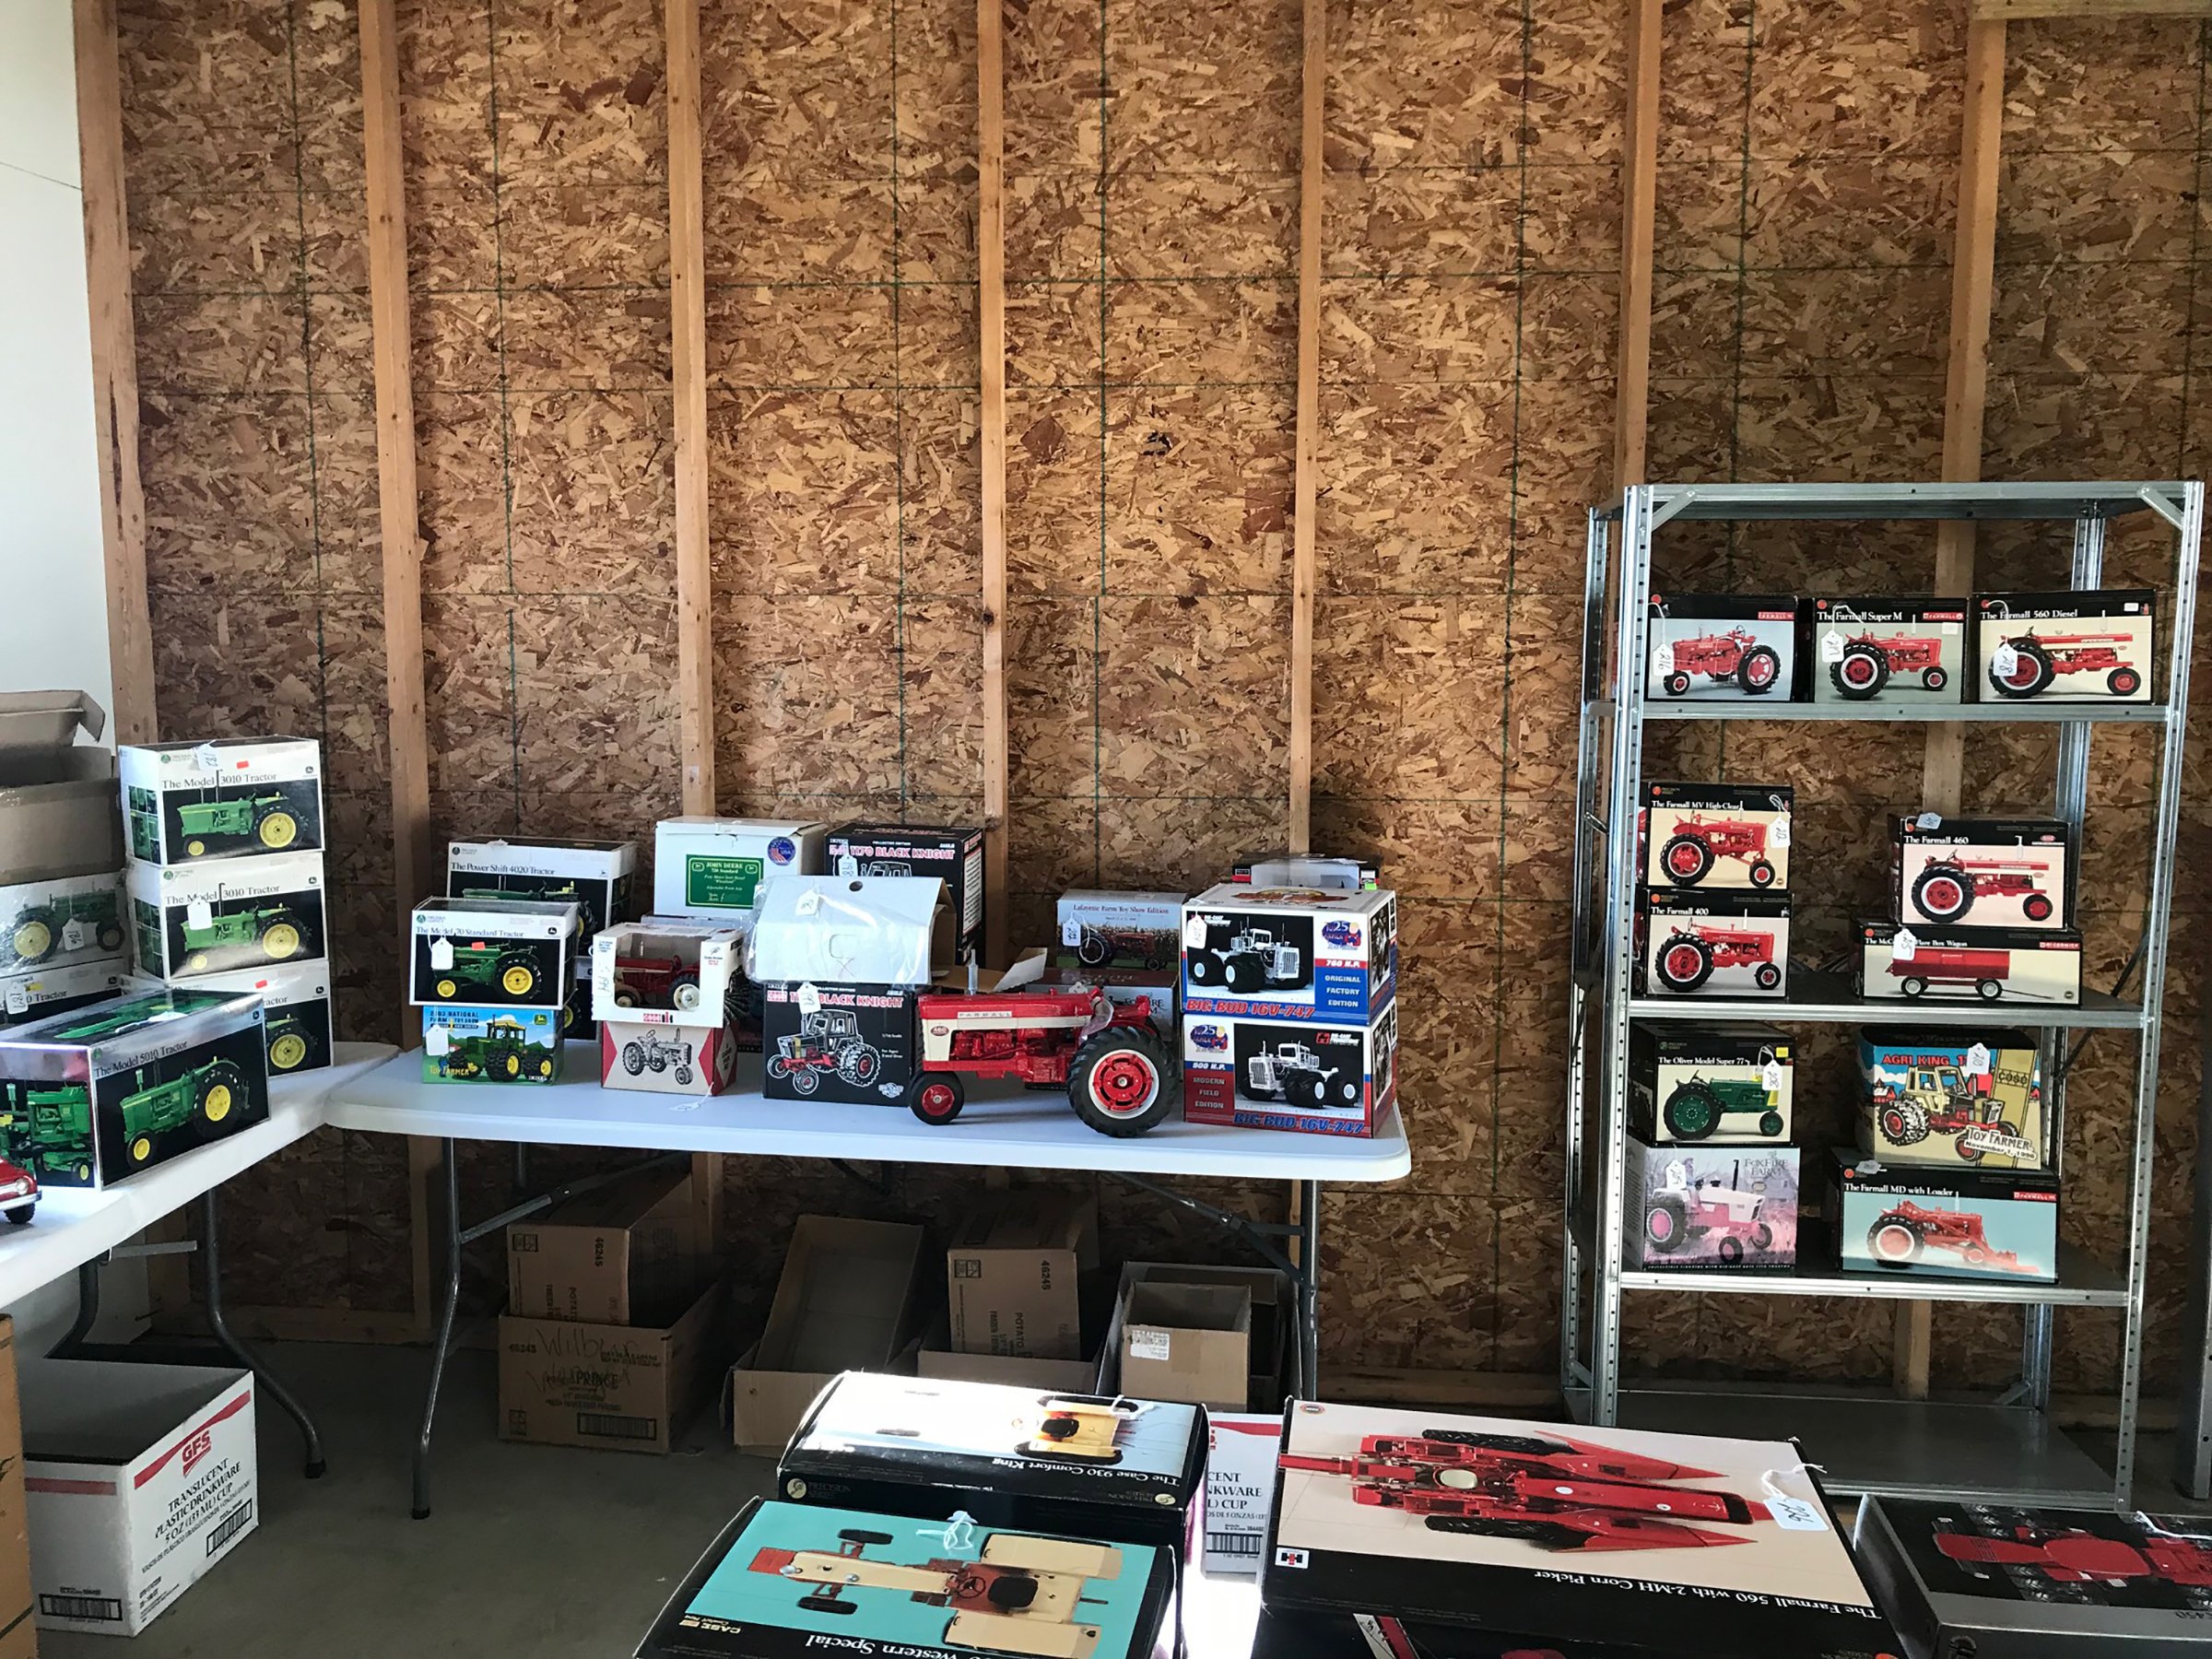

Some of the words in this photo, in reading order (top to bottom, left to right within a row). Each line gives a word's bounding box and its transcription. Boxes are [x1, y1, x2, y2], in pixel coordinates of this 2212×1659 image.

[1818, 612, 1833, 620] The
[1836, 612, 1867, 620] Farmall
[1868, 612, 1892, 622] Super
[1893, 612, 1902, 620] M
[1981, 611, 1996, 619] The
[2000, 610, 2030, 619] Farmall
[2033, 610, 2050, 618] 560
[2052, 609, 2077, 618] Diesel
[1659, 651, 1671, 669] 216
[2000, 655, 2015, 673] 218
[163, 779, 182, 790] The
[183, 776, 215, 788] Model
[221, 775, 242, 785] 3010
[244, 773, 277, 783] Tractor
[1706, 802, 1741, 810] High-Clear
[876, 846, 911, 858] BLACK
[912, 848, 955, 860] KNIGHT
[451, 863, 466, 871] The
[467, 864, 489, 872] Power
[490, 865, 508, 873] Shift
[509, 865, 529, 874] 4020
[530, 866, 556, 876] Tractor
[166, 896, 184, 905] The
[223, 888, 245, 899] 3010
[248, 886, 280, 896] Tractor
[1147, 906, 1170, 914] Edition
[465, 928, 498, 936] Standard
[500, 929, 525, 937] Tractor
[1324, 975, 1360, 983] ORIGINAL
[36, 991, 67, 1002] Tractor
[1326, 987, 1360, 995] FACTORY
[265, 996, 288, 1006] ractor
[819, 992, 856, 1006] BLACK
[857, 994, 904, 1007] KNIGHT
[1328, 999, 1359, 1008] EDITION
[1186, 998, 1212, 1012] BIG
[1215, 1001, 1248, 1015] BUD
[1250, 1003, 1316, 1019] 16V-747
[95, 1066, 112, 1077] The
[112, 1055, 140, 1071] Model
[140, 1049, 160, 1064] 5010
[162, 1041, 189, 1057] Tractor
[1673, 1056, 1693, 1065] Oliver
[1716, 1057, 1735, 1066] Super
[1882, 1054, 1912, 1065] AGRI
[1917, 1055, 1950, 1065] KING
[1194, 1077, 1225, 1086] MODERN
[1199, 1089, 1219, 1098] FIELD
[1194, 1100, 1224, 1109] EDITION
[1233, 1112, 1262, 1124] BIG
[1264, 1114, 1297, 1129] BUD
[1300, 1118, 1365, 1135] 16V-747
[1965, 1141, 2005, 1152] November
[1844, 1182, 1859, 1192] The
[1861, 1183, 1888, 1193] Farmall
[1890, 1185, 1906, 1194] MD
[1908, 1186, 1924, 1194] with
[1926, 1187, 1954, 1196] Loader
[595, 1237, 605, 1267] 46245
[1041, 1260, 1052, 1290] 46245
[1015, 1312, 1025, 1348] POTATO
[182, 1430, 211, 1463] GFS
[992, 1456, 1025, 1470] King
[1029, 1463, 1085, 1476] Comfort
[1088, 1467, 1113, 1477] 930
[1117, 1472, 1149, 1482] Case
[169, 1458, 229, 1512] TRANSLUCENT
[1153, 1475, 1181, 1488] The
[1207, 1485, 1263, 1498] NKWARE
[156, 1504, 190, 1539] PLASTIC
[190, 1462, 241, 1511] DRINKWARE
[1221, 1500, 1247, 1510] CUP
[171, 1522, 184, 1540] OZ
[217, 1482, 233, 1502] CUP
[1230, 1512, 1255, 1520] ONZAS
[1777, 1502, 1813, 1524] 226
[1535, 1571, 1585, 1585] Picker
[1590, 1577, 1633, 1590] Corn
[1639, 1582, 1687, 1596] 2-MH
[1691, 1586, 1730, 1599] with
[1736, 1593, 1769, 1606] 560
[1774, 1597, 1841, 1614] Farmall
[1844, 1606, 1882, 1619] The
[700, 1622, 741, 1634] CASE
[806, 1634, 876, 1654] Special
